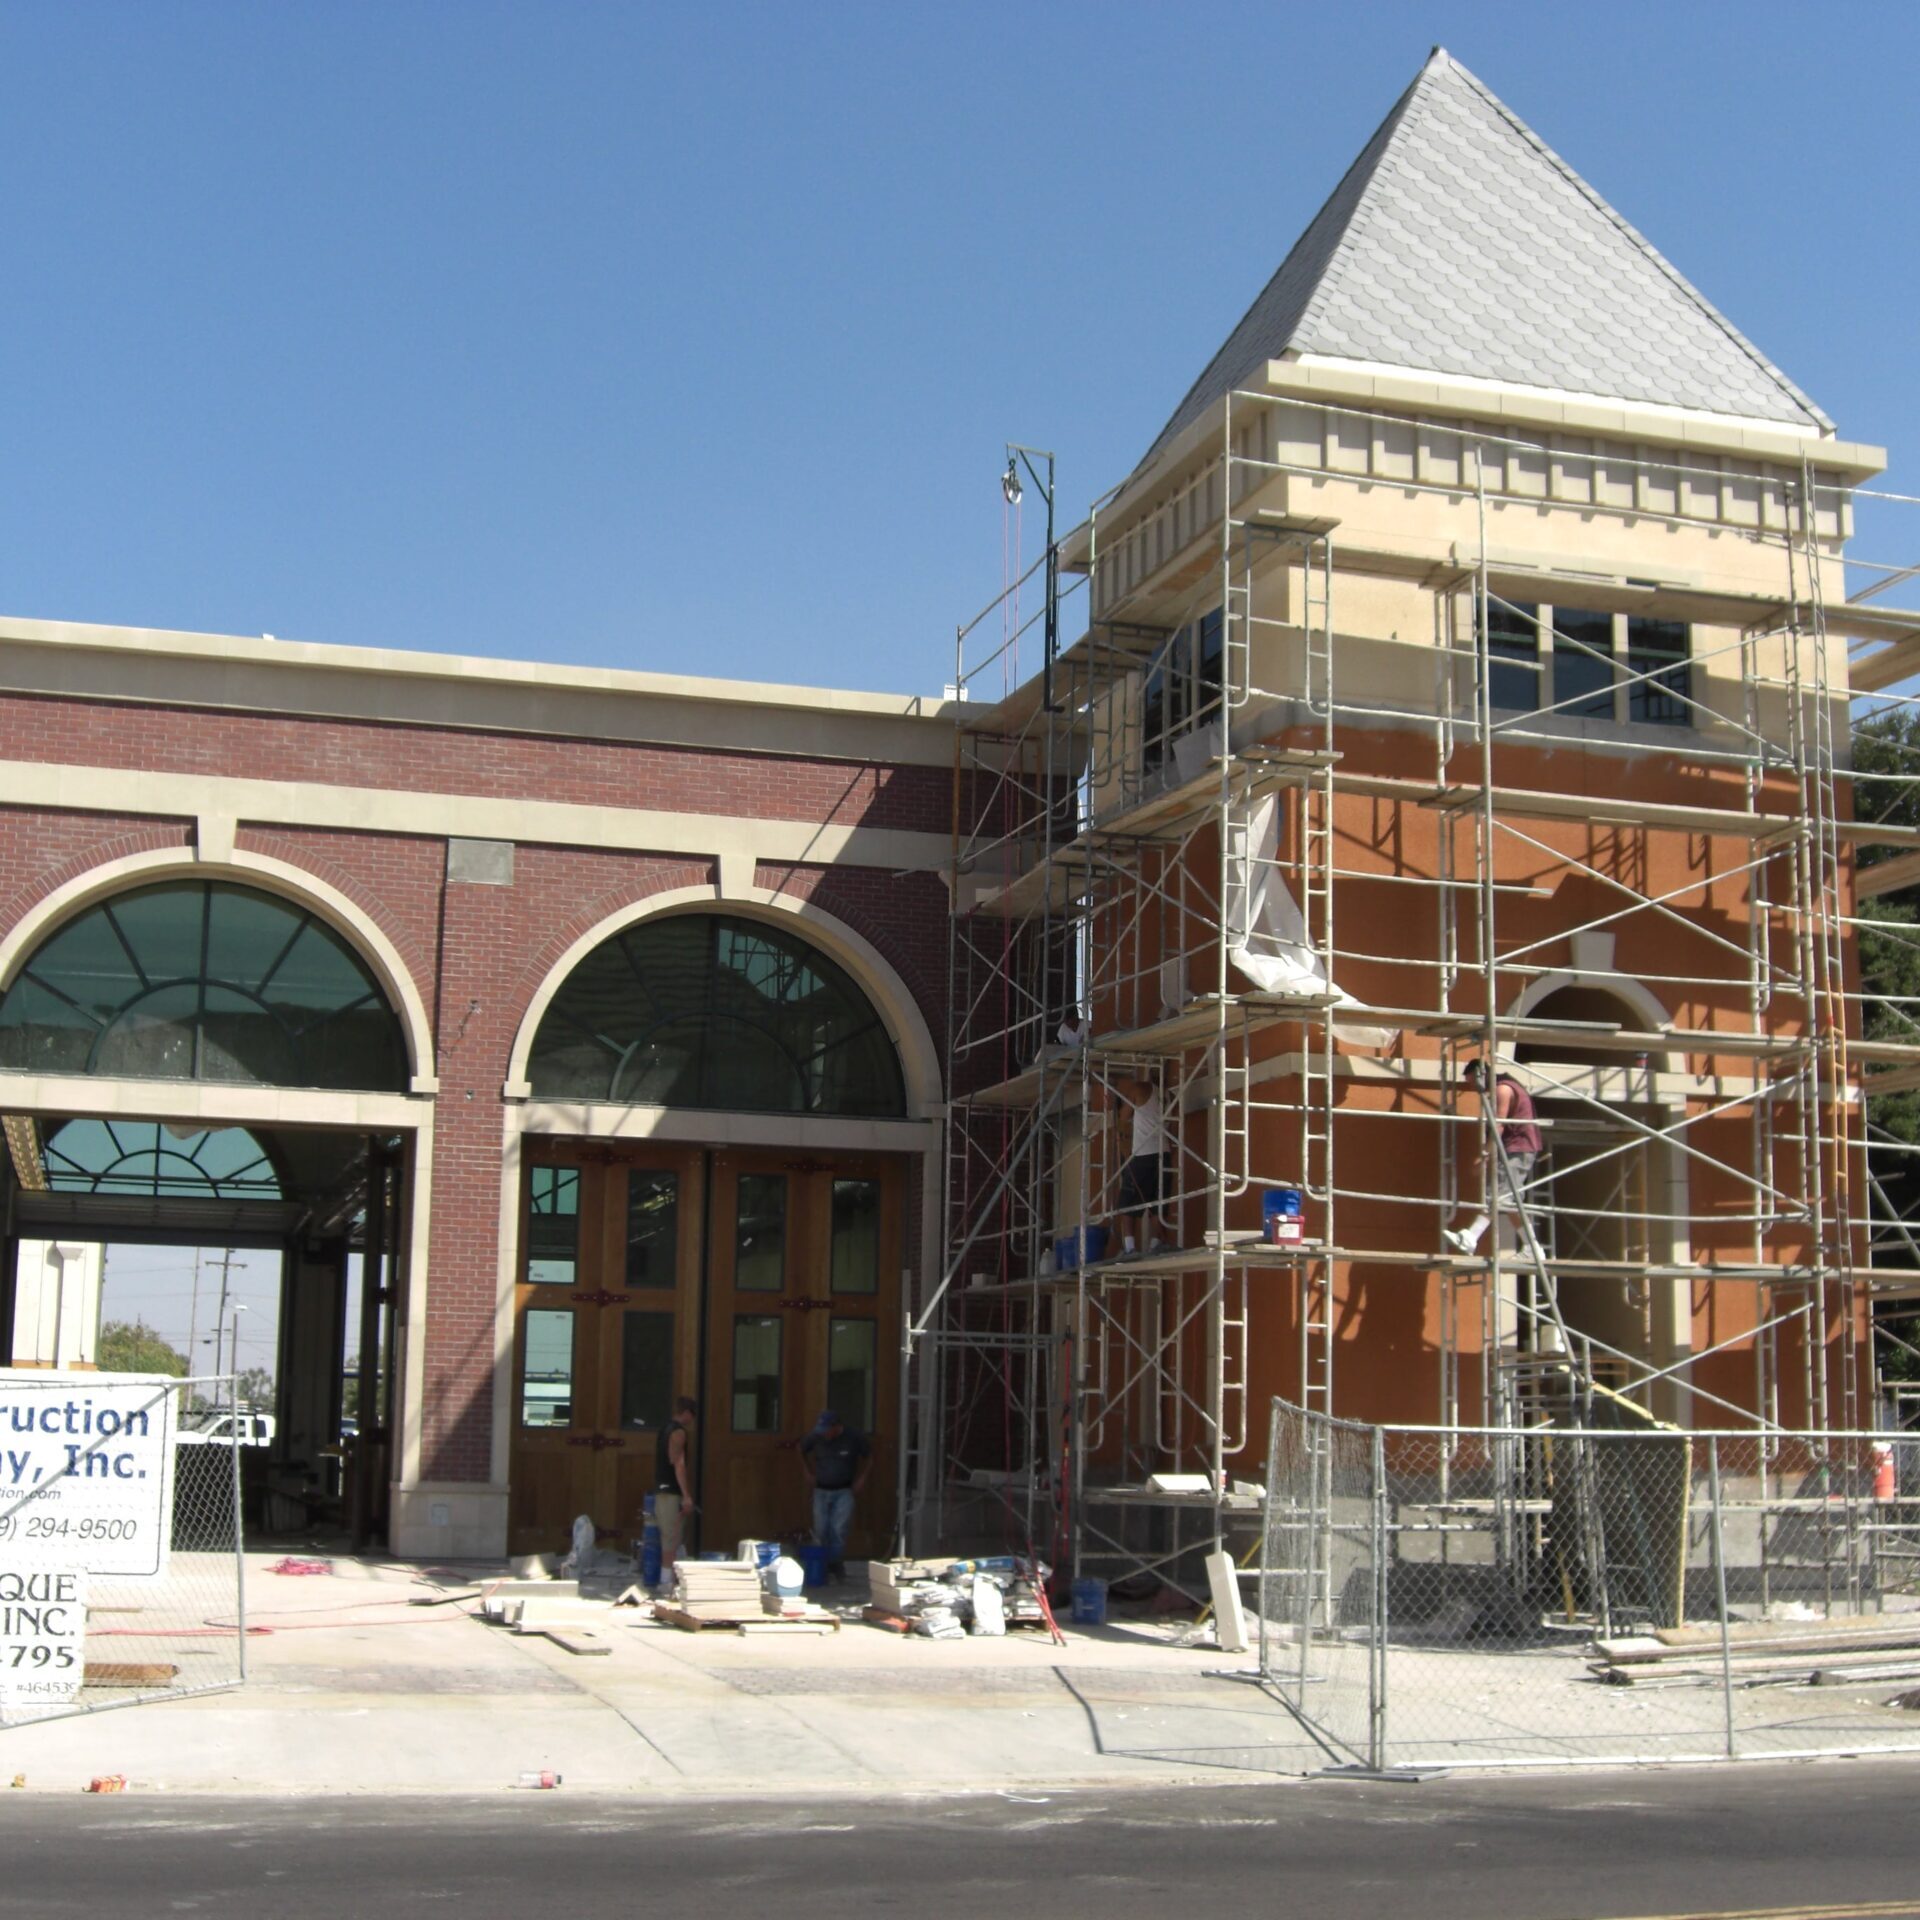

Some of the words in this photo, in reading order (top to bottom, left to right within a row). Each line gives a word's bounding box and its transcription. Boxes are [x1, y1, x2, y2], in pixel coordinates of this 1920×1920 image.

[0, 1450, 43, 1484] y,
[64, 1444, 146, 1479] Inc.
[0, 1486, 61, 1500] ion.com
[26, 1517, 137, 1540] 294-9500
[0, 1573, 77, 1602] QUE
[4, 1607, 75, 1636] INC.
[0, 1645, 74, 1668] 795
